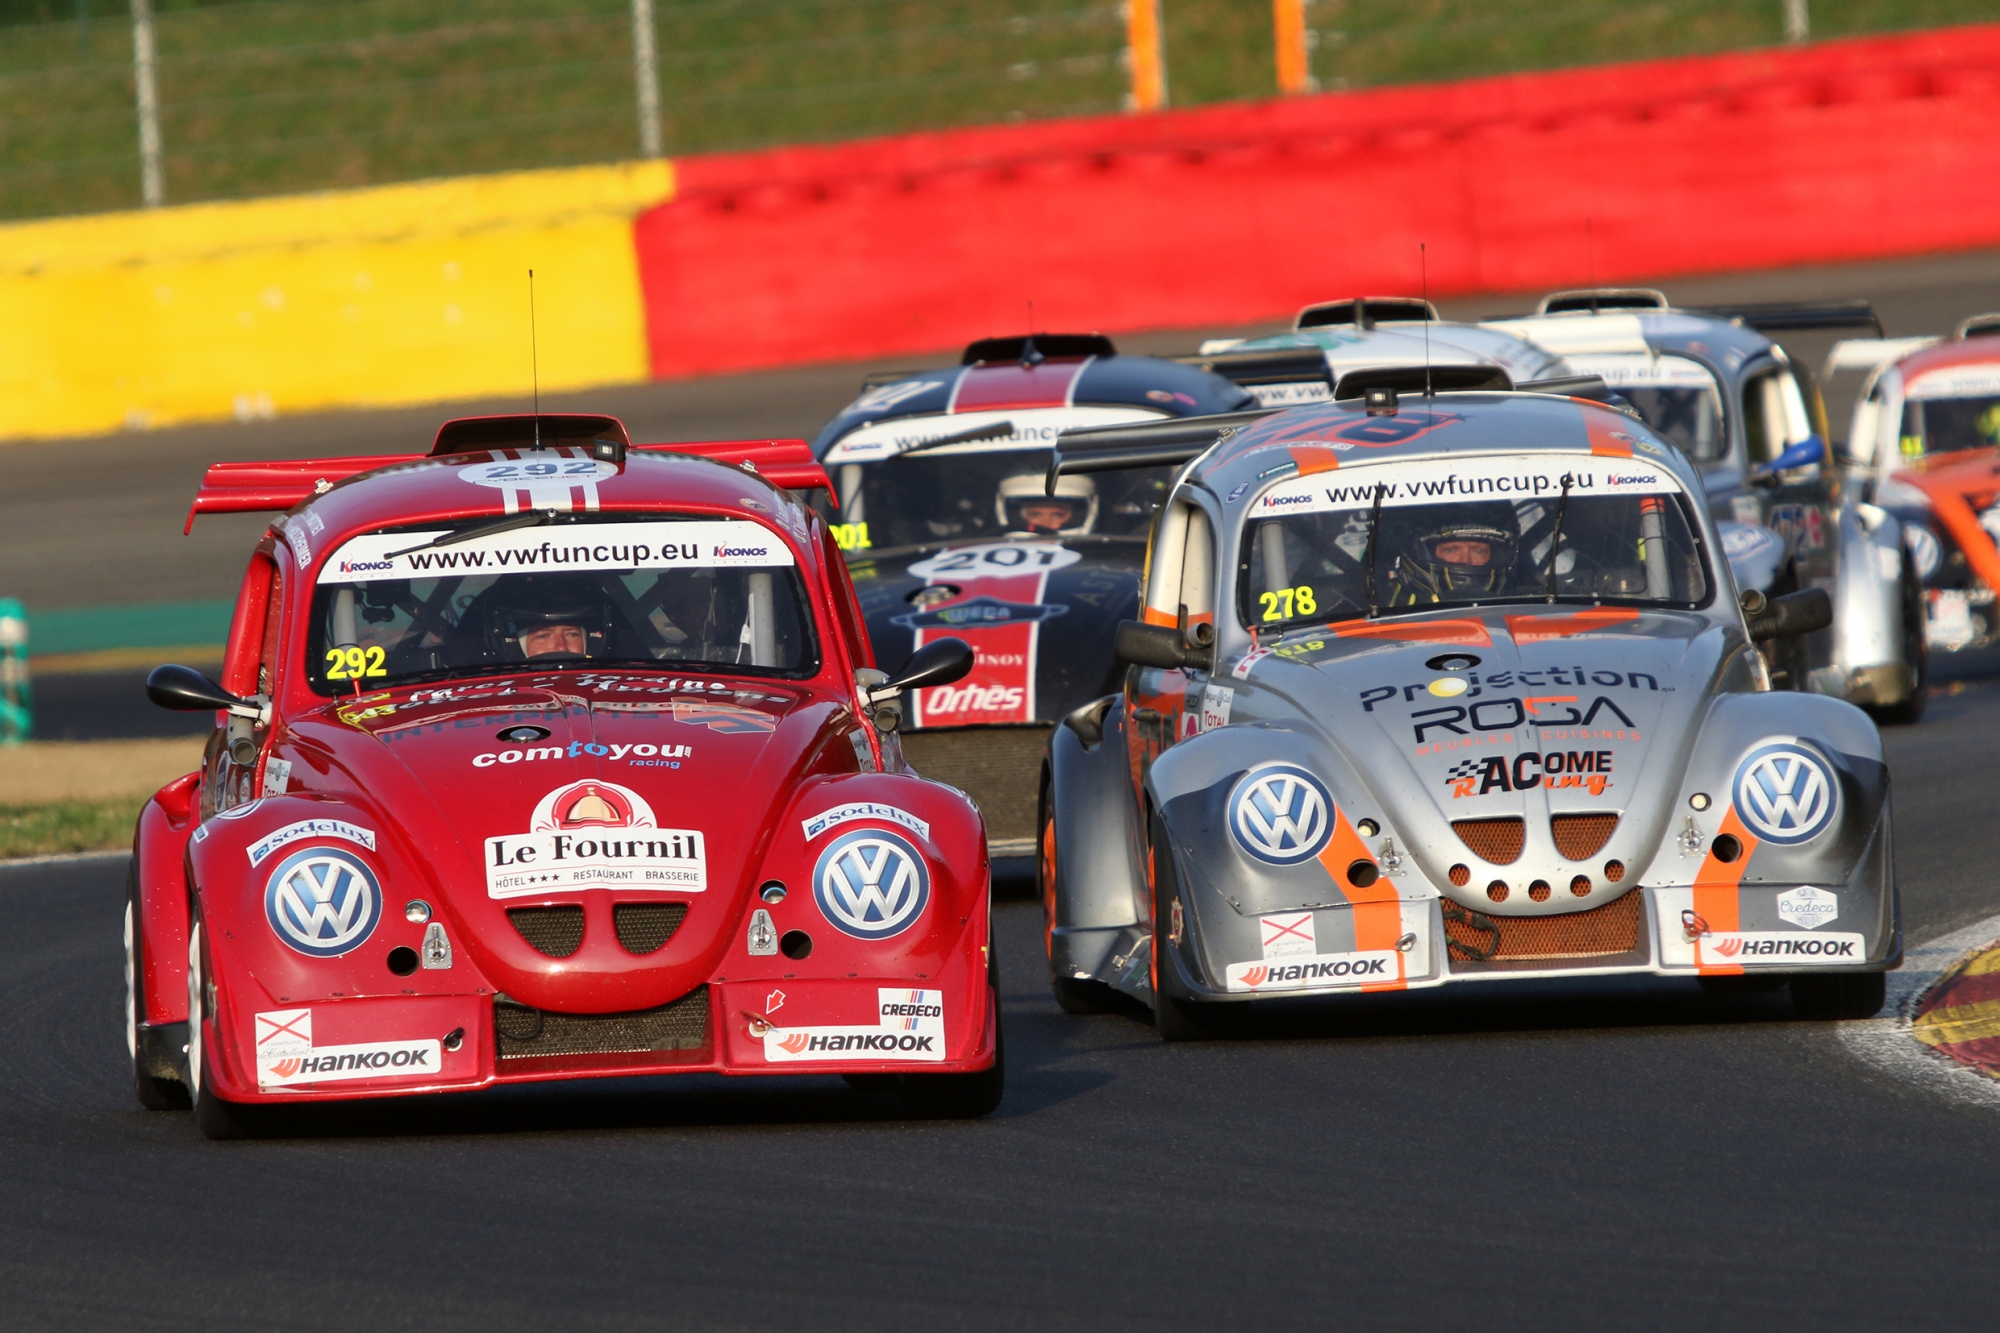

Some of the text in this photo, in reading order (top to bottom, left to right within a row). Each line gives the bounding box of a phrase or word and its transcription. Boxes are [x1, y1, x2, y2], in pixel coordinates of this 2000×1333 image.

[486, 461, 598, 479] 292
[1607, 471, 1657, 486] KRONOS
[1263, 493, 1313, 508] KRONOS
[408, 542, 699, 570] www.vwfuncup.eu
[713, 543, 768, 558] KRONOS
[932, 547, 1060, 572] 201
[339, 558, 394, 573] KRONOS
[1259, 585, 1318, 622] 278
[325, 645, 388, 680] 292
[1411, 696, 1637, 744] ROSA
[472, 740, 685, 768] comtoyou
[1416, 729, 1642, 757] MEUBLES CUISINES
[629, 757, 682, 770] racing
[829, 804, 926, 835] sodelux
[271, 821, 371, 848] sodelux
[492, 835, 699, 867] Le Fournil
[495, 870, 700, 889] HÔTEL RESTAURANT BRASSERIE
[881, 1003, 942, 1018] CREDECO
